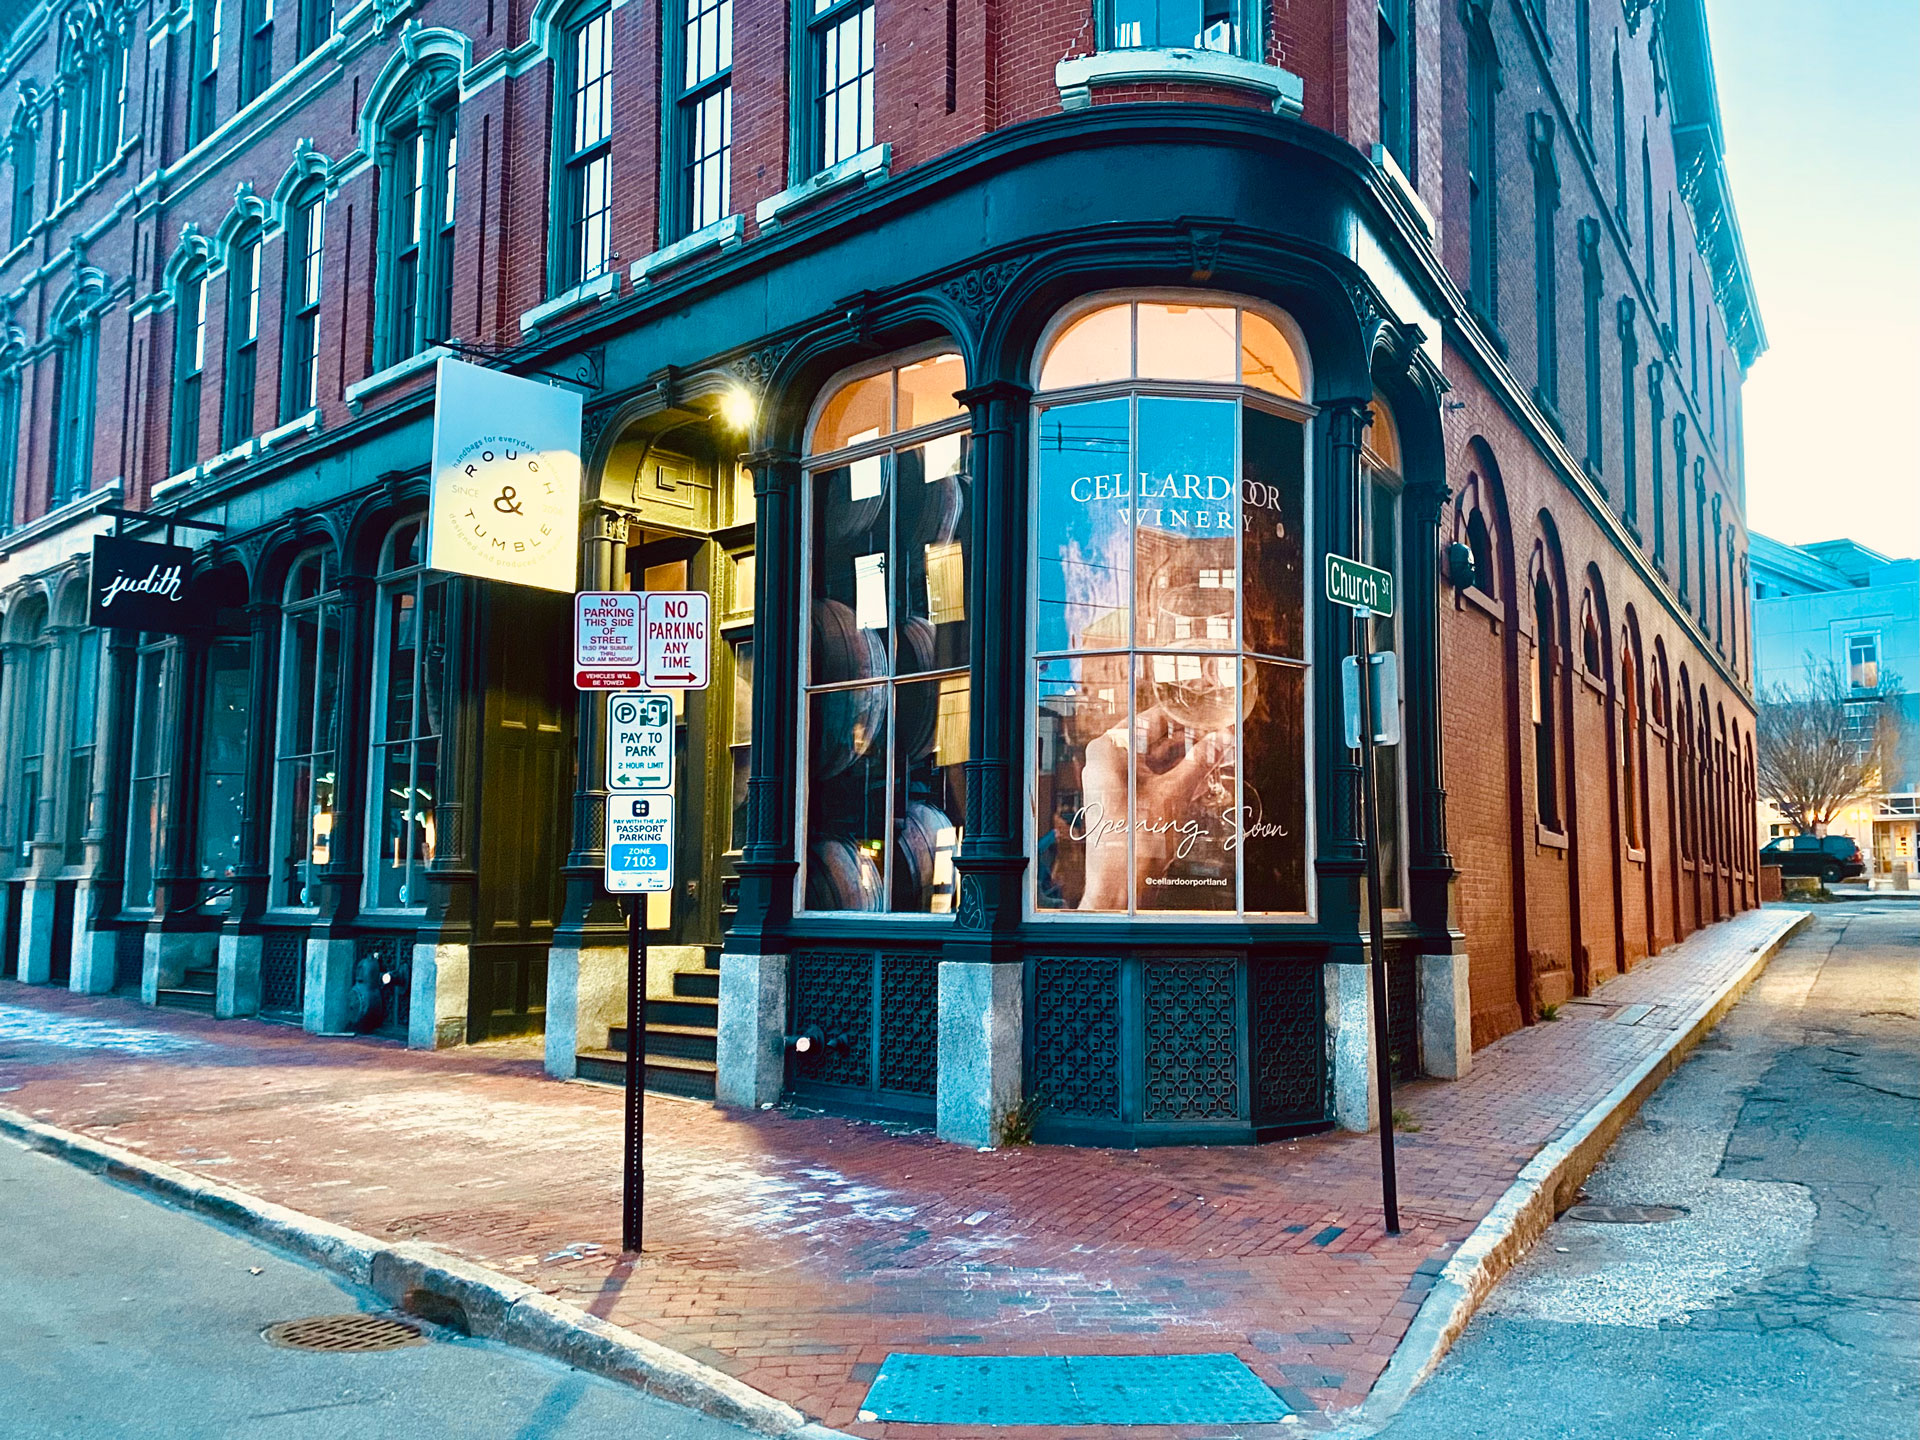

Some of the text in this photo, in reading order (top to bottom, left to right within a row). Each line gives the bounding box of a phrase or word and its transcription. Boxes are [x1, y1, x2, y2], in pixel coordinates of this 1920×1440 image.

[452, 436, 534, 468] handbags for everyday
[464, 449, 555, 495] ROUGH
[451, 484, 479, 499] SINCE
[1070, 472, 1282, 511] CELLARDOOR
[494, 486, 523, 516] &
[1118, 508, 1253, 532] WINERY
[449, 513, 478, 551] designed
[464, 507, 553, 553] TUMBLE
[100, 565, 182, 607] judith
[1331, 562, 1389, 606] Church St
[600, 598, 618, 607] NO
[584, 608, 634, 618] PARKING
[665, 601, 688, 618] NO
[585, 619, 634, 627] THIS SIDE
[649, 622, 704, 640] PARKING
[590, 636, 628, 644] STREET
[664, 642, 689, 654] ANY
[661, 656, 691, 668] TIME
[620, 732, 662, 743] PAY TO
[625, 745, 656, 757] PARK
[616, 824, 665, 833] PASSPORT
[1070, 802, 1288, 859] Opening Soon
[619, 833, 662, 841] PARKING
[628, 847, 651, 855] ZONE
[623, 856, 656, 867] 7103
[1145, 877, 1228, 888] @cellardoorportland
